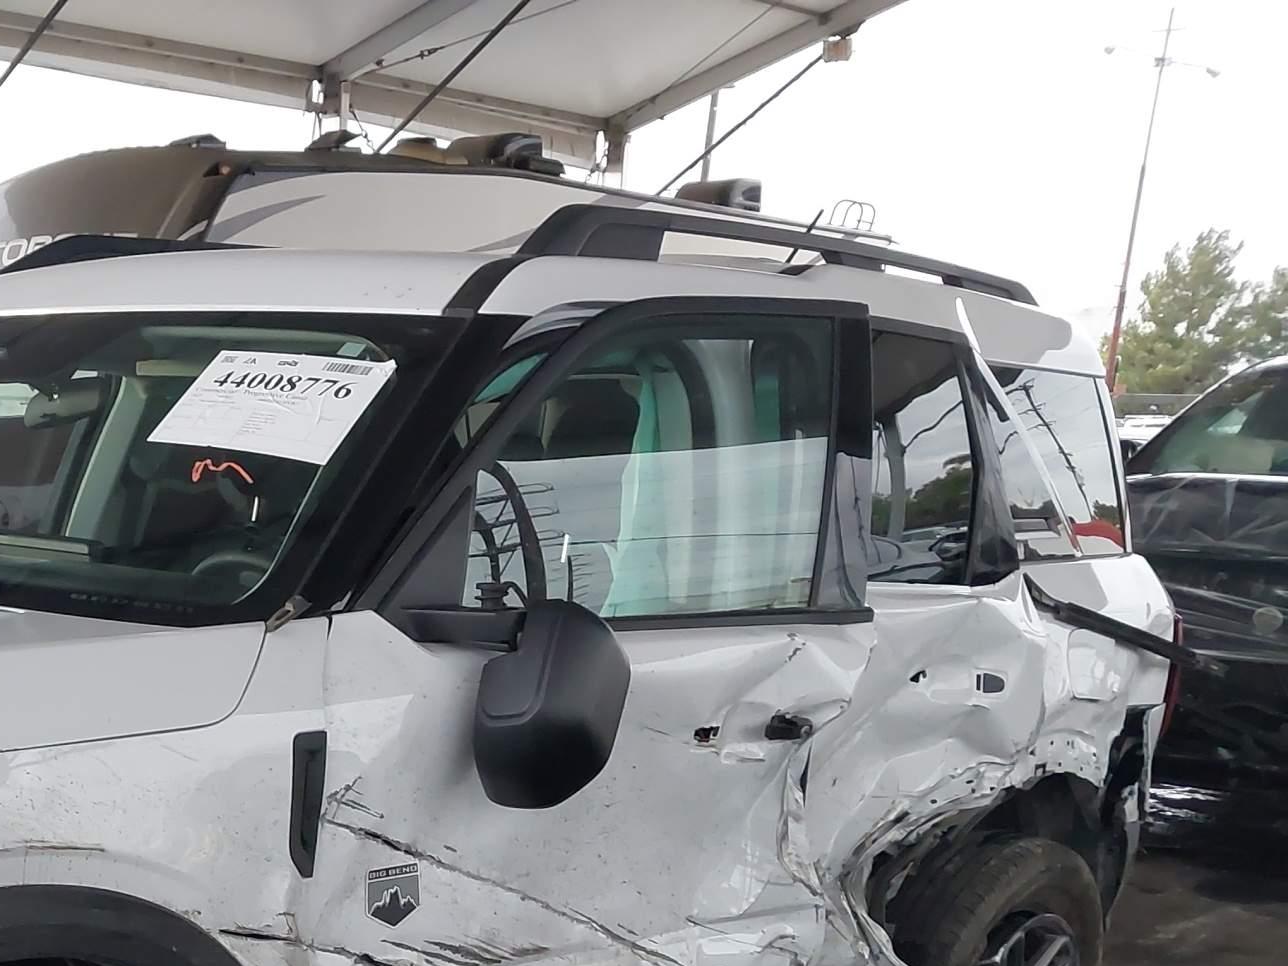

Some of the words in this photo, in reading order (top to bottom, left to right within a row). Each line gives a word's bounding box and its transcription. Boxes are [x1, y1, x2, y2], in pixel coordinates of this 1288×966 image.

[213, 370, 358, 399] 44008776
[369, 870, 387, 879] BIG
[388, 865, 417, 876] BEND
